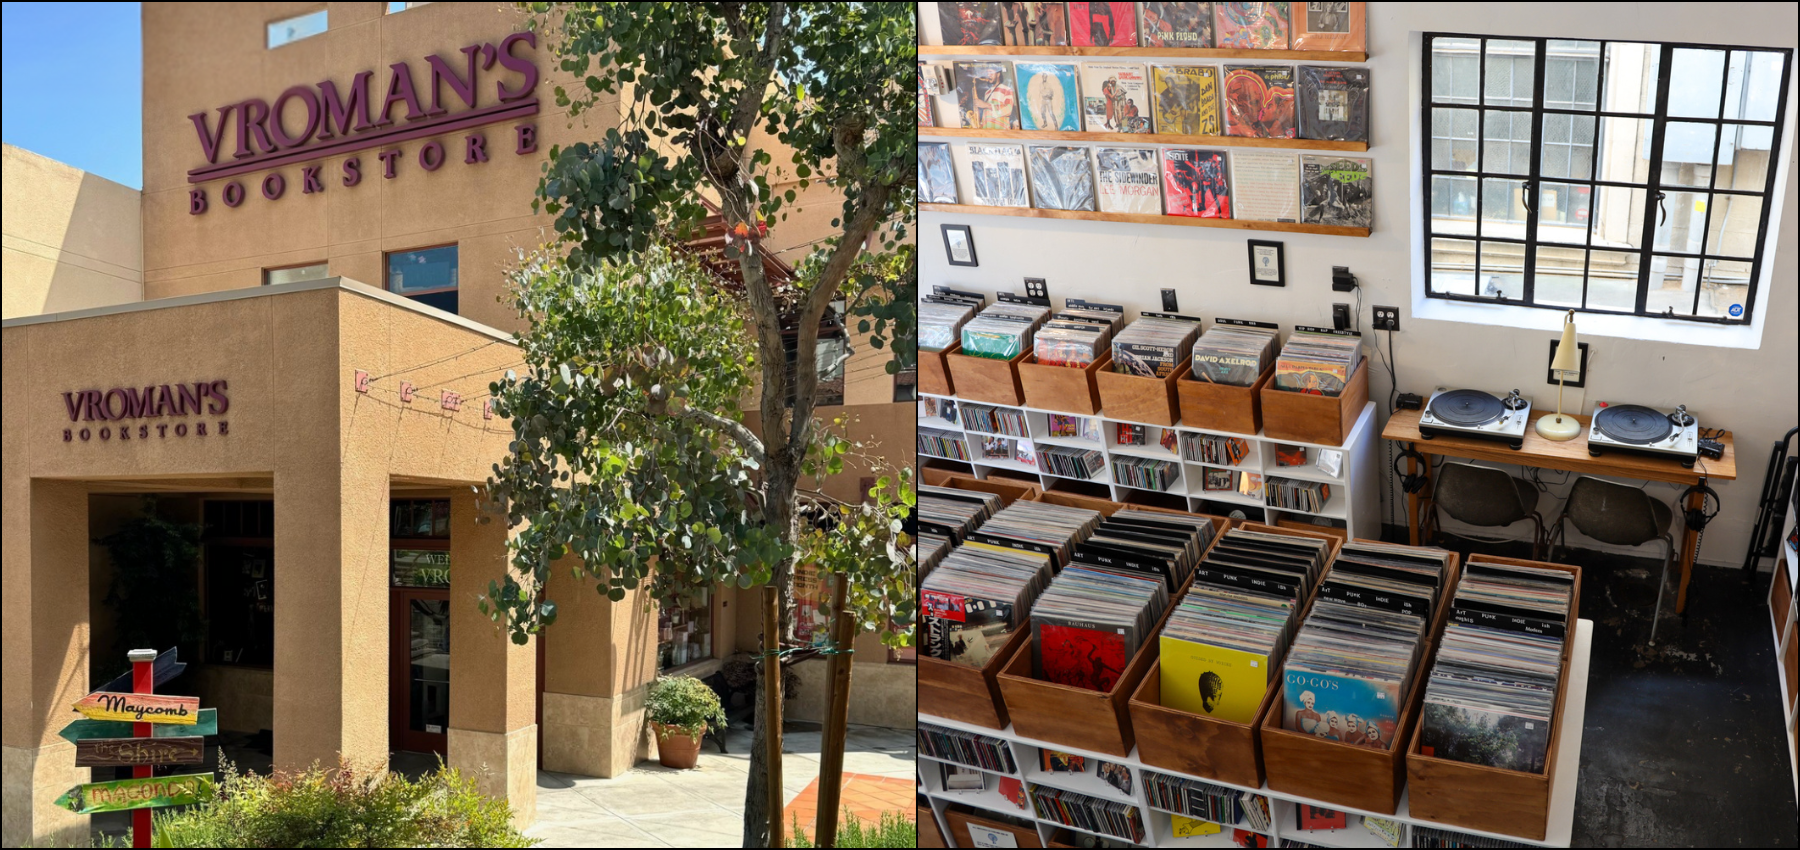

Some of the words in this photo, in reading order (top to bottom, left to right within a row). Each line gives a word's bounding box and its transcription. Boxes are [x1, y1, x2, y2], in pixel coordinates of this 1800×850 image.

[1175, 32, 1198, 42] FLOYD
[187, 30, 539, 164] VROMAN'S
[188, 123, 538, 216] BOOKSTORE
[1114, 171, 1158, 185] SIDEWINDER
[1099, 184, 1116, 195] LEE
[1120, 185, 1159, 196] MORGAN
[1195, 354, 1218, 363] DAVID
[1218, 356, 1257, 367] AXELROD
[61, 380, 229, 422] VROMAN'S
[62, 420, 229, 443] BOOKSTORE
[1097, 556, 1112, 564] PUNK
[1251, 579, 1266, 587] INDIE
[1067, 621, 1096, 629] BAUHAUS
[97, 694, 188, 720] Maycomb
[118, 743, 178, 764] Shire
